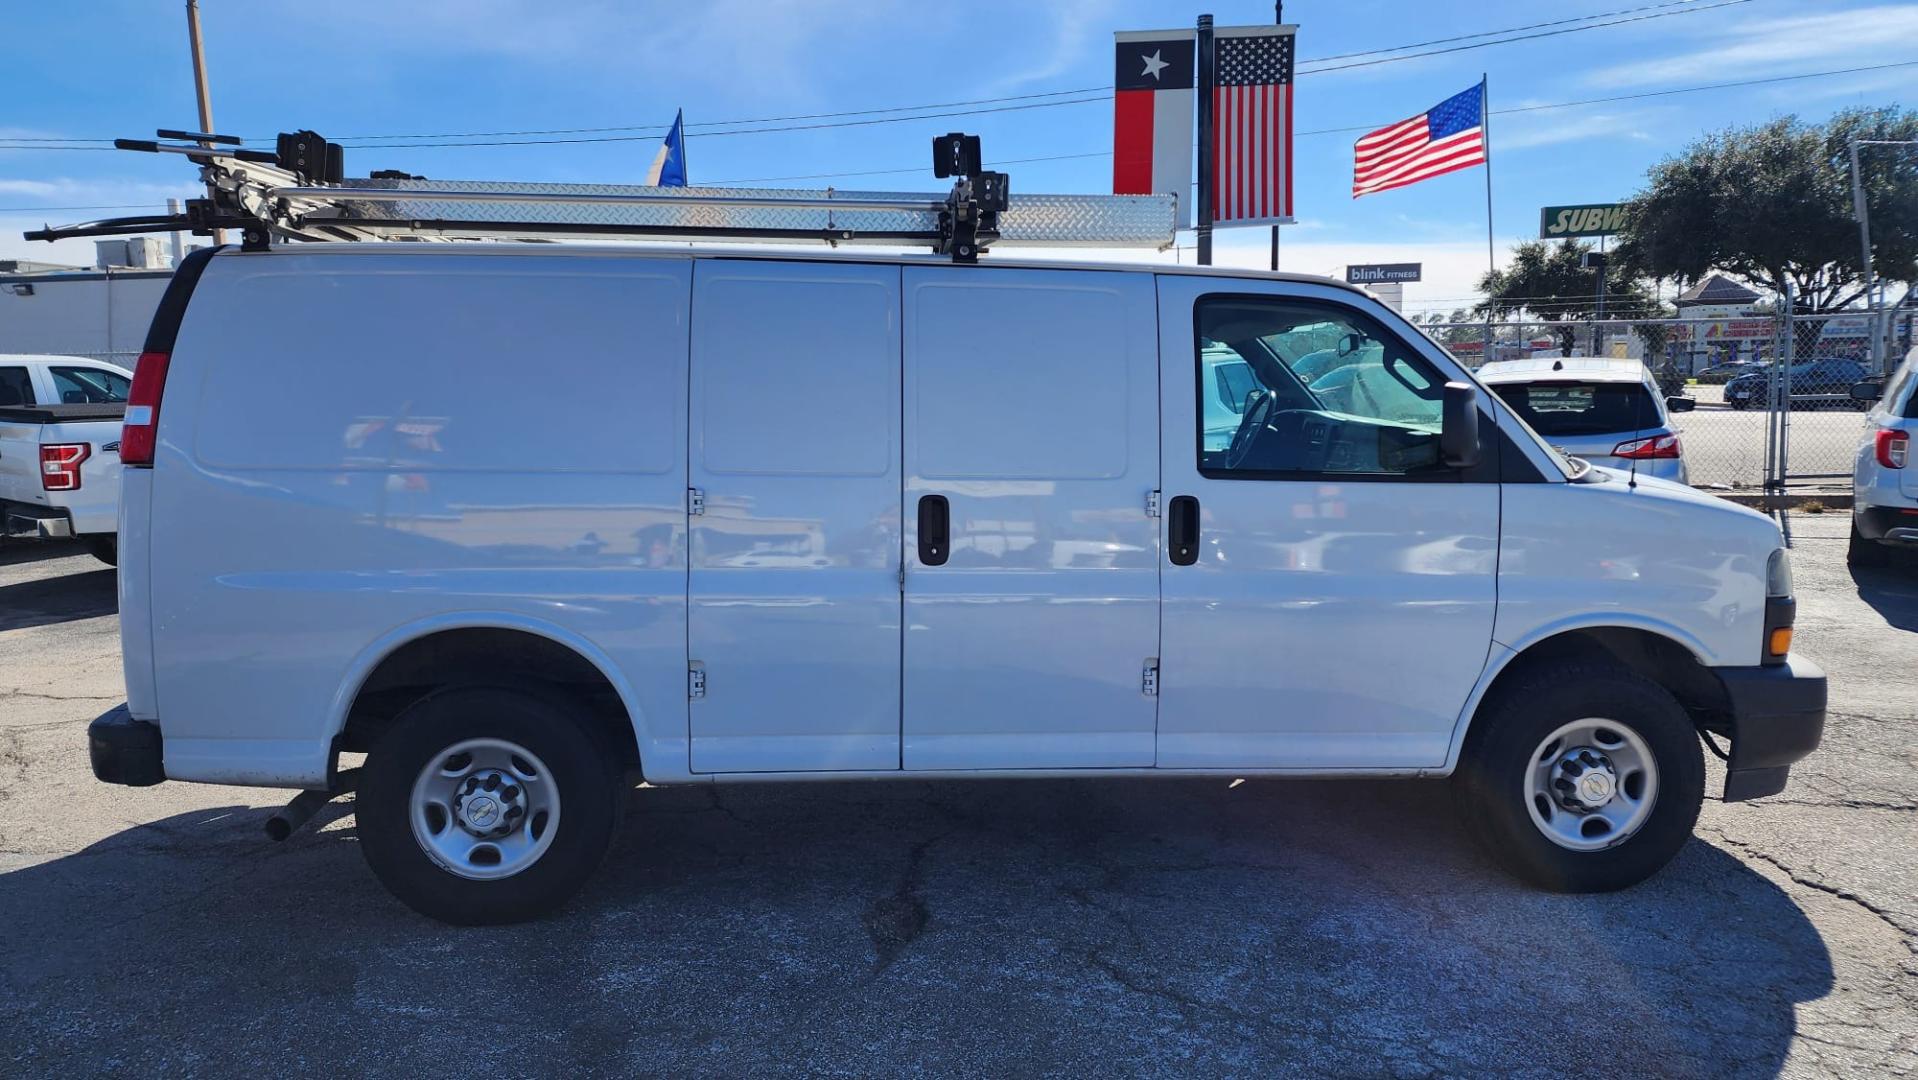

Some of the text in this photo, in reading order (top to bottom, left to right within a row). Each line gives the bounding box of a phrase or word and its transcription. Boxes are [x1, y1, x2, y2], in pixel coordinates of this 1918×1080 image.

[1548, 208, 1626, 234] SUBW
[1351, 267, 1418, 280] blink FITNESS
